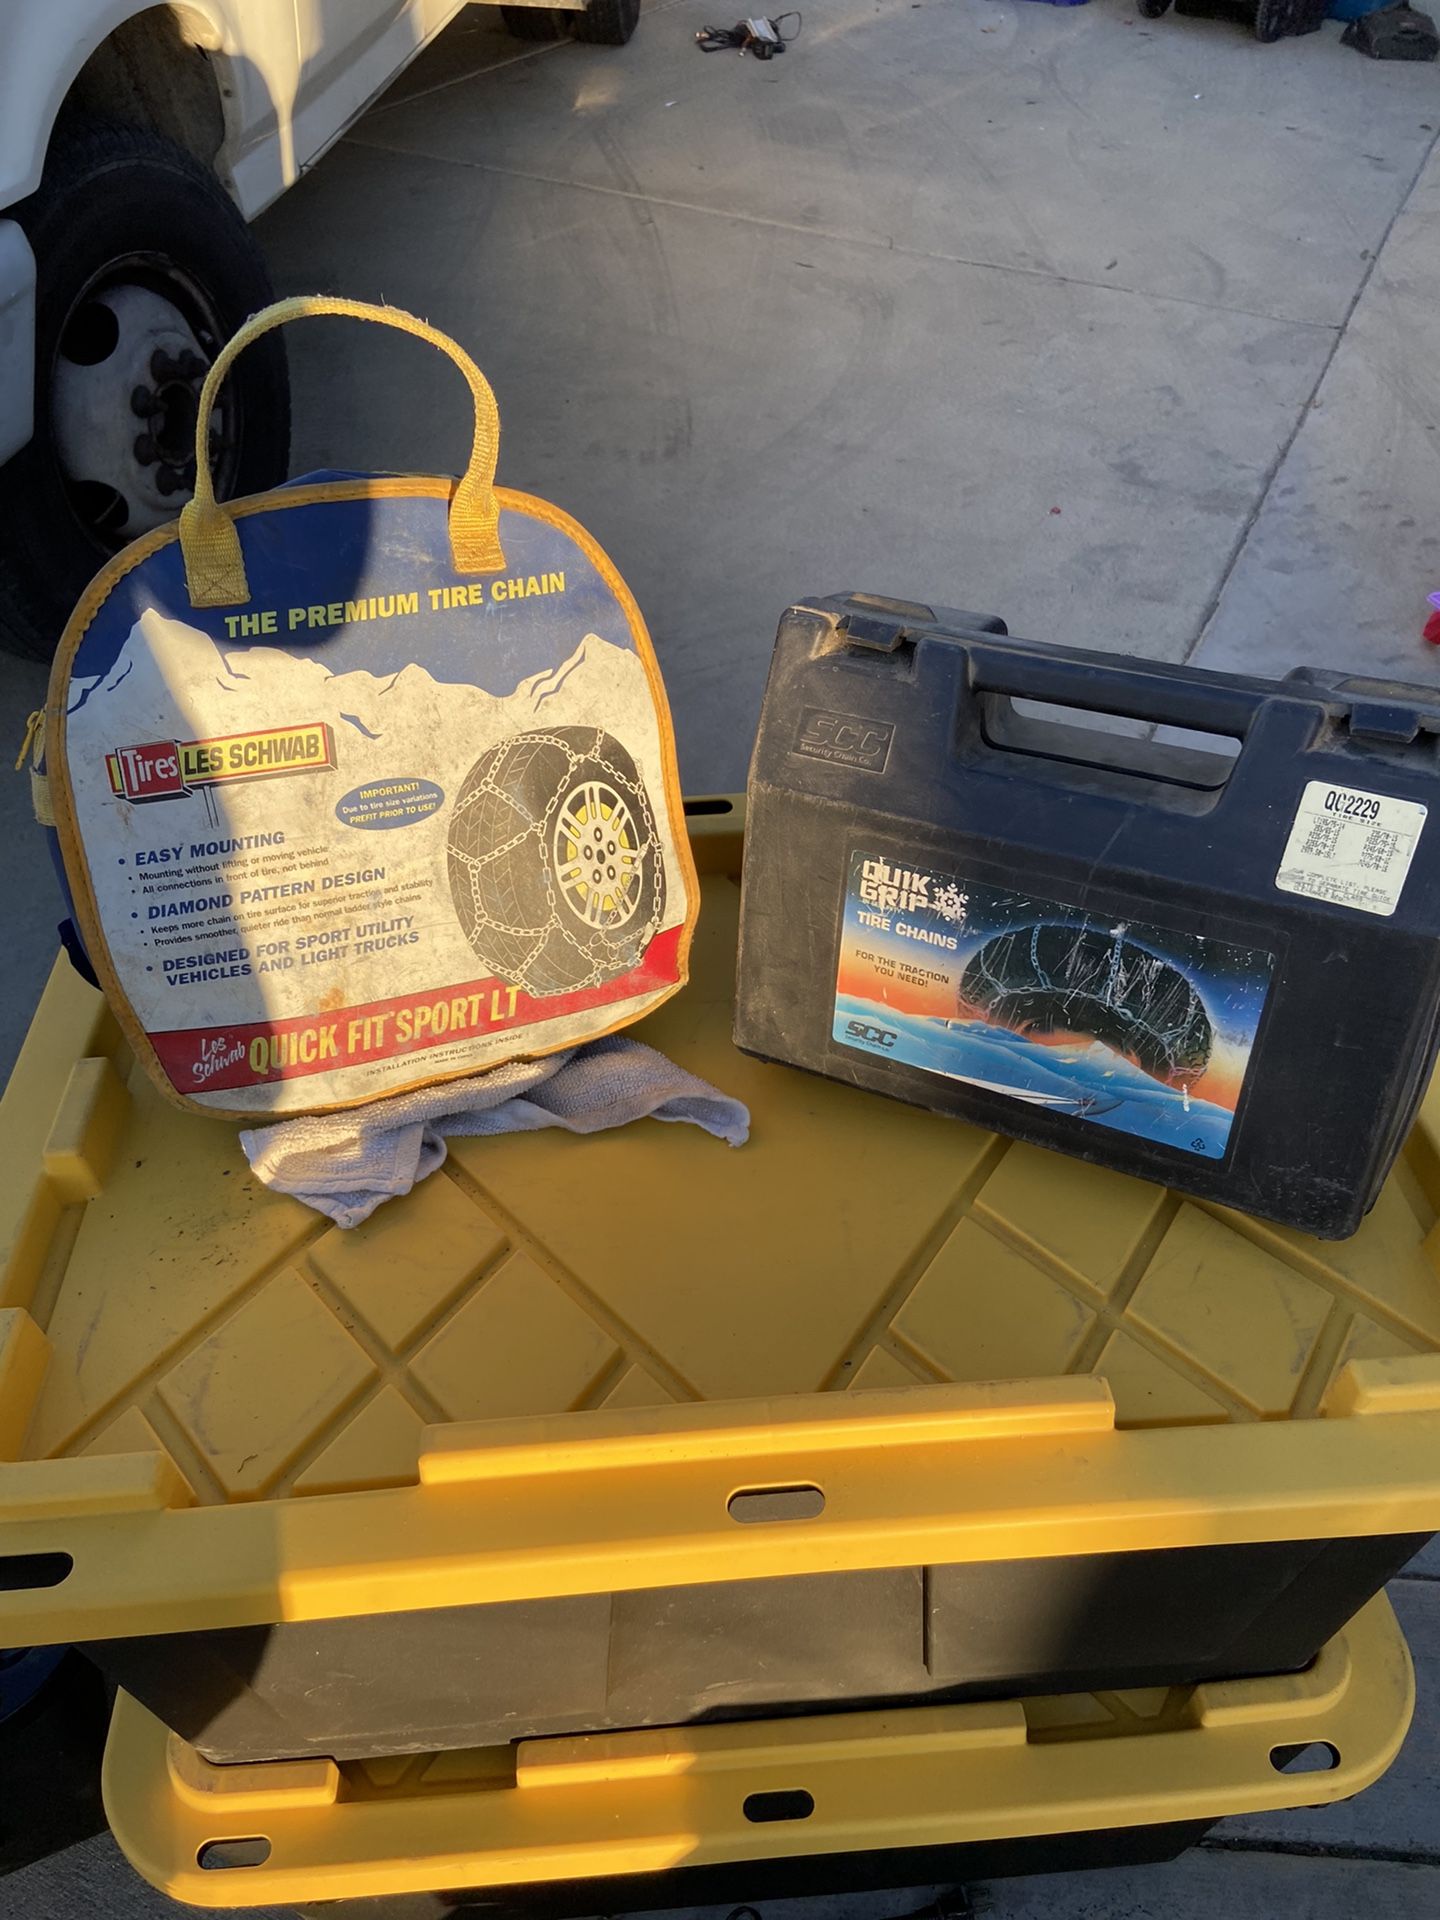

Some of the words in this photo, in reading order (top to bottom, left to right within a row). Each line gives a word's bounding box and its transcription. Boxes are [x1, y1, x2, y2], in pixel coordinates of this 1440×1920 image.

[224, 611, 278, 638] THE
[288, 592, 418, 631] PREMIUM
[428, 584, 483, 610] TIRE
[492, 572, 566, 602] CHAIN
[800, 715, 889, 756] SCC
[800, 743, 832, 758] Security
[834, 750, 857, 762] Chain
[122, 749, 178, 792] Tires
[184, 746, 224, 776] LES
[229, 734, 320, 768] SCHWAB
[342, 806, 358, 814] Due
[386, 798, 400, 806] size
[402, 792, 438, 804] variations
[360, 782, 420, 800] IMPORTANT!
[350, 812, 378, 823] PREFIT
[380, 809, 404, 818] PRIOR
[406, 806, 416, 814] TO
[418, 802, 436, 812] USE!
[136, 846, 184, 866] EASY
[190, 831, 285, 858] MOUNTING
[139, 868, 184, 881] Mounting
[185, 862, 220, 874] without
[223, 858, 248, 868] lifting
[262, 851, 295, 862] moving
[297, 846, 329, 857] vehicle
[142, 886, 154, 894] All
[157, 878, 212, 893] connections
[226, 871, 248, 882] front
[250, 869, 259, 877] of
[262, 866, 280, 876] tire,
[282, 863, 297, 872] not
[299, 859, 329, 870] behind
[148, 894, 233, 920] DIAMOND
[240, 880, 315, 904] PATTERN
[322, 867, 386, 890] DESIGN
[862, 860, 932, 896] QUIK
[151, 923, 179, 935] Keeps
[182, 921, 204, 930] more
[207, 915, 231, 926] chain
[234, 912, 245, 921] on
[247, 909, 262, 918] tire
[264, 903, 296, 916] surface
[299, 901, 310, 910] for
[312, 895, 346, 907] superior
[348, 889, 381, 900] traction
[384, 884, 399, 894] and
[401, 879, 433, 892] stability
[860, 880, 928, 912] GRIP
[154, 935, 193, 947] Provides
[195, 927, 239, 940] smoother,
[240, 922, 271, 935] quieter
[274, 918, 290, 927] ride
[292, 915, 312, 924] than
[313, 908, 343, 920] normal
[344, 903, 370, 915] ladder
[372, 898, 392, 910] style
[395, 894, 422, 905] chains
[857, 911, 892, 931] TIRE
[896, 922, 958, 950] CHAINS
[163, 948, 250, 972] DESIGNED
[257, 940, 290, 957] FOR
[296, 928, 350, 950] SPORT
[356, 915, 414, 938] UTILITY
[166, 964, 252, 986] VEHICLES
[258, 956, 294, 973] AND
[301, 945, 348, 966] LIGHT
[354, 931, 419, 954] TRUCKS
[855, 950, 874, 961] FOR
[877, 956, 896, 968] THE
[900, 963, 950, 984] TRACTION
[874, 965, 894, 977] YOU
[898, 973, 928, 988] NEED!
[250, 1024, 338, 1074] QUICK
[348, 1012, 392, 1054] FIT
[395, 993, 485, 1044] SPORT
[490, 984, 522, 1021] LT
[845, 1020, 898, 1047] SCC
[192, 1041, 246, 1084] Schwab
[202, 1037, 227, 1062] Les
[366, 1056, 427, 1076] INSTALLATION
[429, 1040, 492, 1059] INSTRUCTIONS
[495, 1034, 523, 1044] INSIDE
